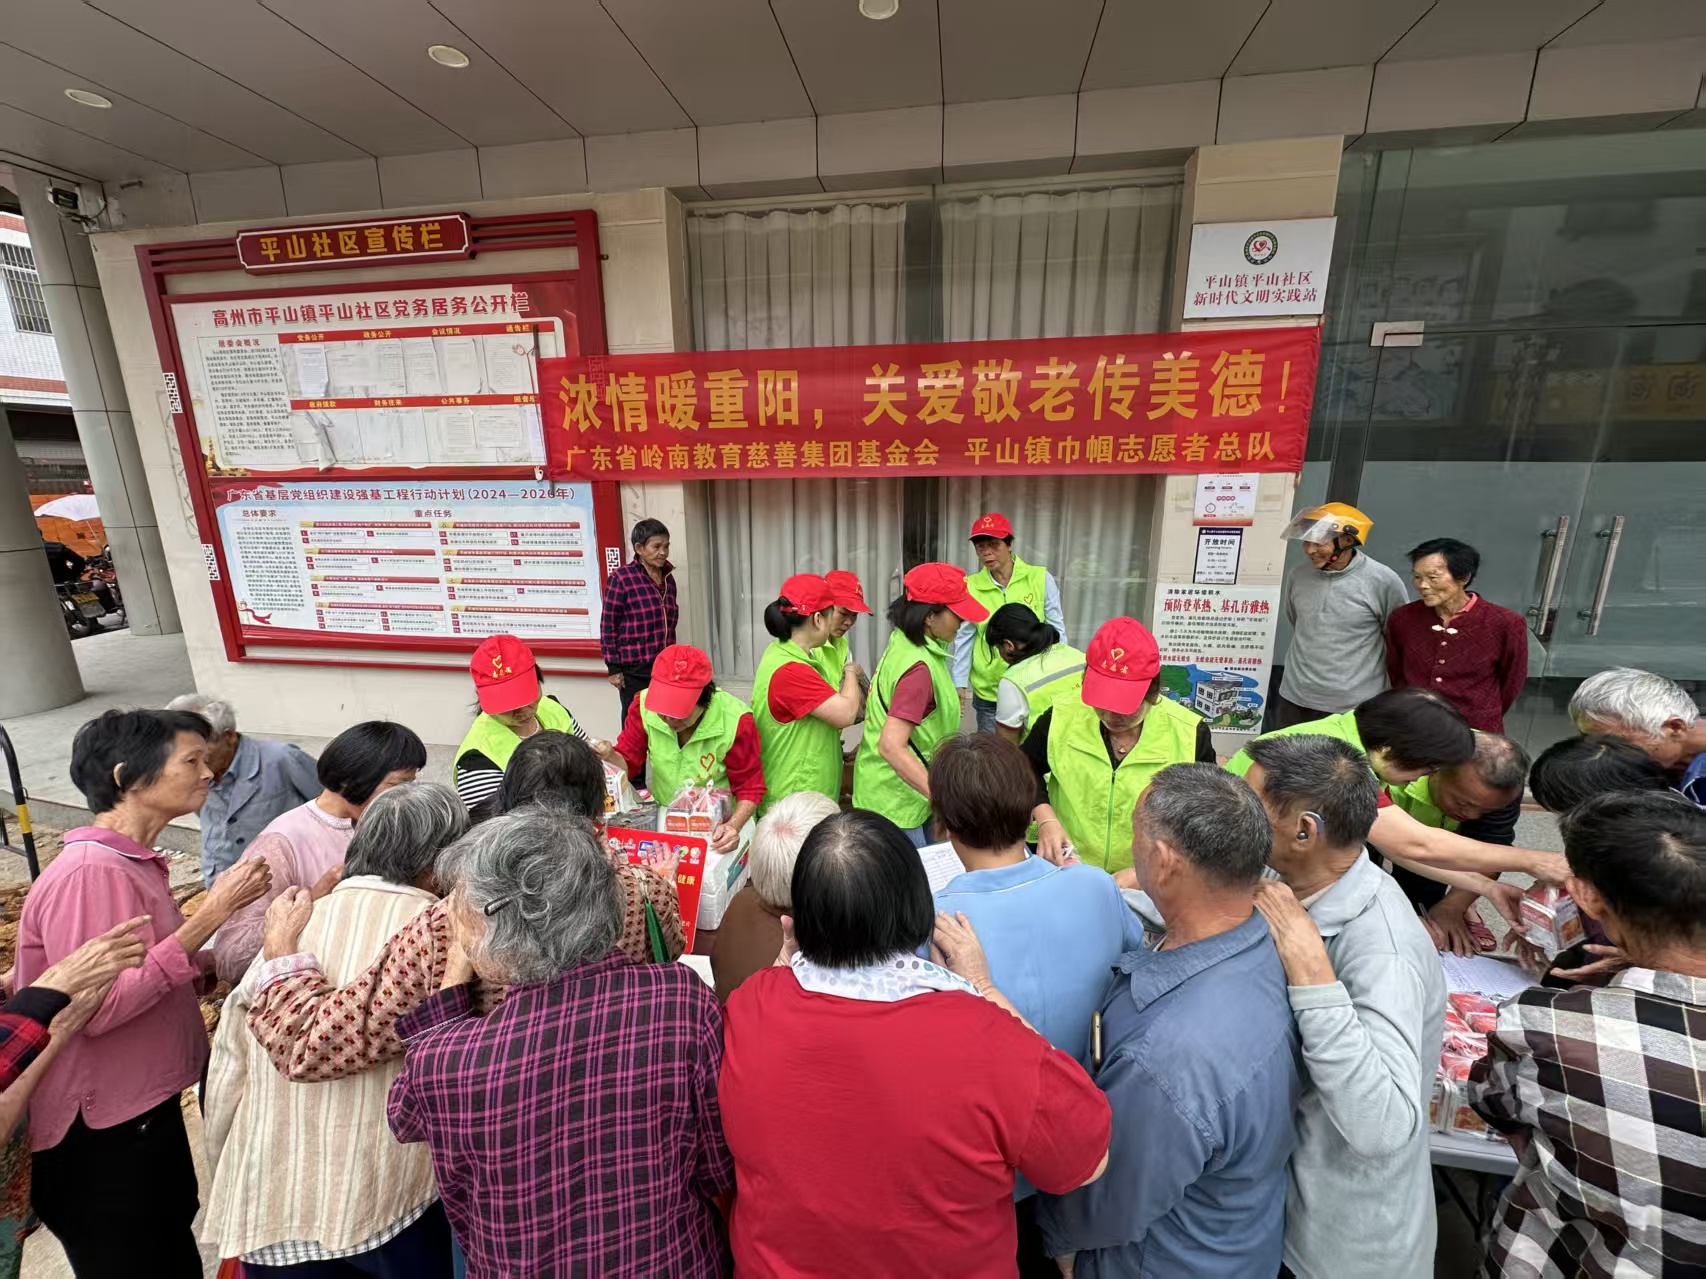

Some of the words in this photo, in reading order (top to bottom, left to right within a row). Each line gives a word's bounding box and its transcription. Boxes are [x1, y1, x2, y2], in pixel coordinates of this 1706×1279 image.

[259, 222, 443, 262] 平山社区宣传栏
[1205, 270, 1312, 289] 平山镇平山社区
[1193, 287, 1318, 306] 新时代文明实践站
[212, 291, 530, 328] 高州市平山镇平山社区党务居务公开栏
[565, 438, 941, 472] 广东省岭南教育慈善集团基金会
[964, 431, 1277, 466] 平山镇巾帼志愿者总队
[242, 509, 277, 518] 总体要求
[414, 509, 452, 518] 重点任务
[1204, 538, 1235, 546] 开放时间
[1163, 598, 1270, 614] 预防登革热、基孔肯雅热
[677, 874, 695, 885] 健康
